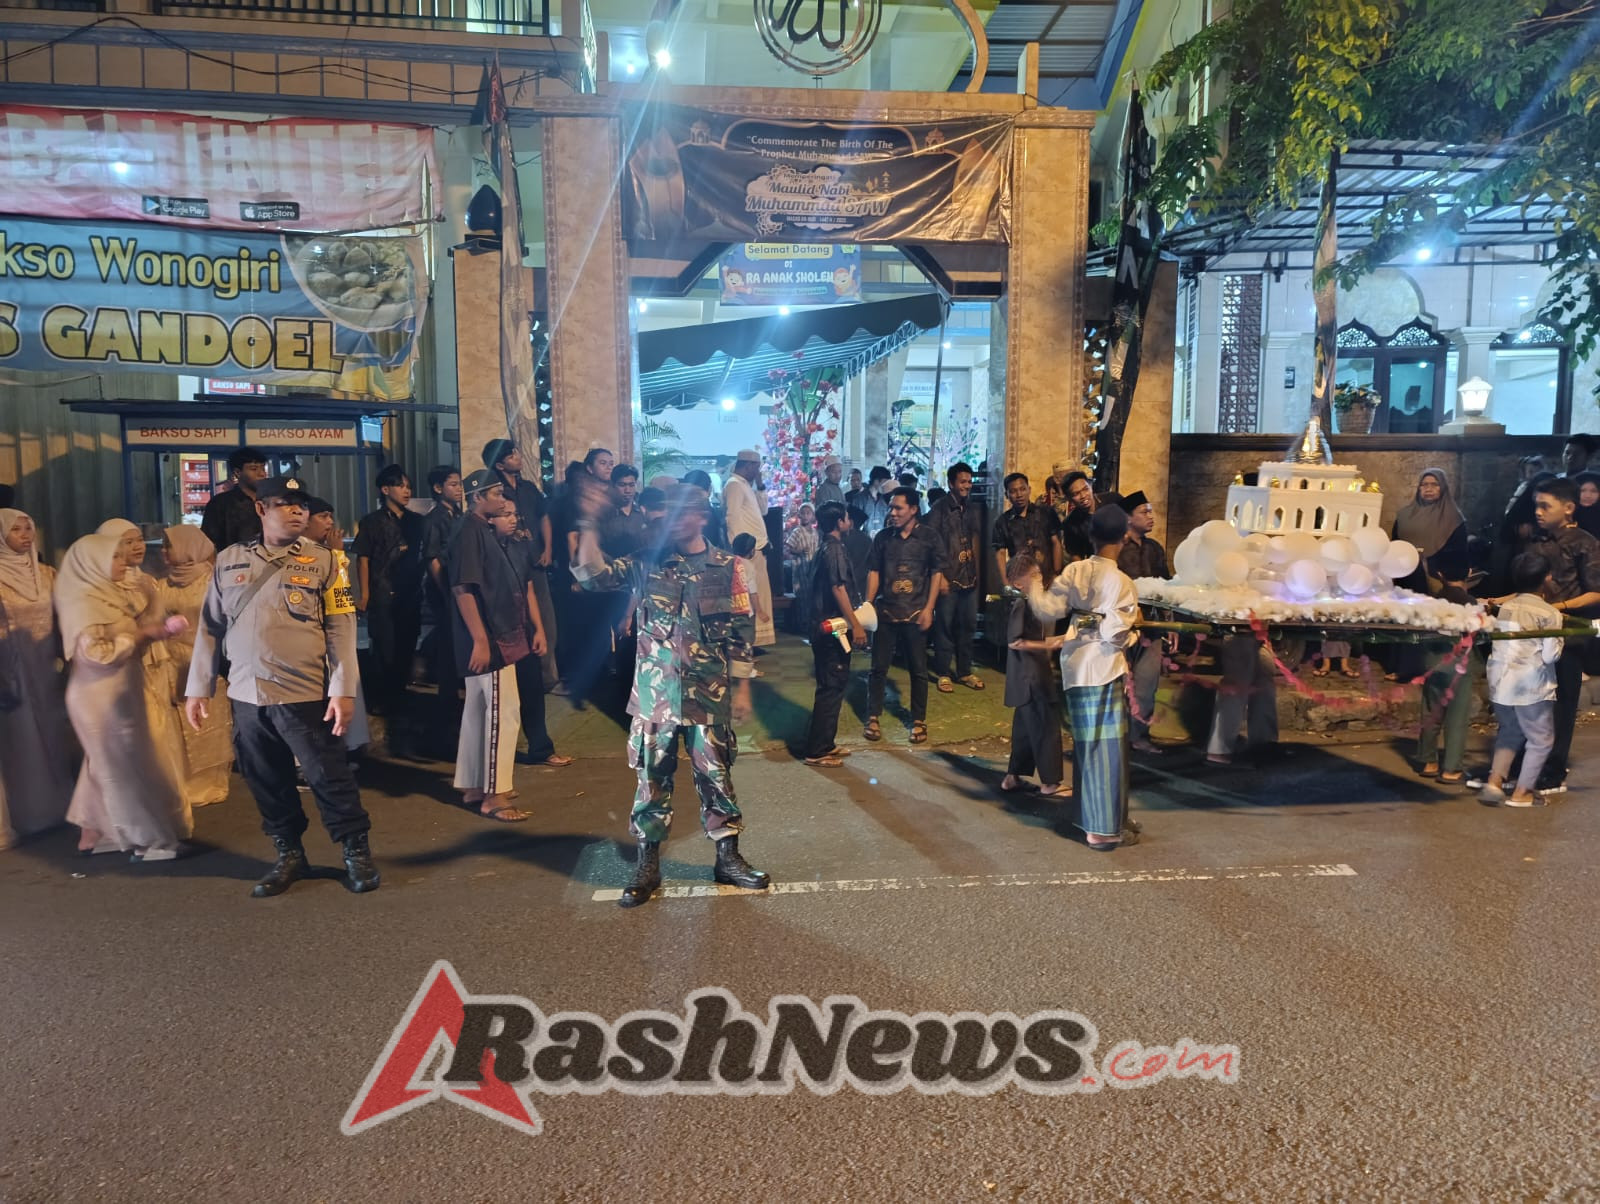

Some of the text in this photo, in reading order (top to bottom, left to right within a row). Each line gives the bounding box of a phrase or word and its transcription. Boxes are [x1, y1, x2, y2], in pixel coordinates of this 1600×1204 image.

[820, 139, 837, 148] The
[840, 140, 861, 148] Birth
[863, 140, 875, 148] Of
[878, 140, 894, 149] The
[761, 150, 796, 160] Prophet
[768, 182, 851, 195] Maulid Nabi
[747, 196, 846, 211] Muhammad
[189, 206, 205, 216] Play
[257, 209, 295, 219] App Store
[748, 244, 830, 255] Selamat Datang
[89, 235, 281, 299] Wonogiri
[746, 272, 760, 284] RA
[763, 272, 794, 283] ANAK
[42, 304, 345, 374] GANDOEL
[140, 427, 227, 439] BAKSO SAPI
[259, 428, 344, 439] BAKSO AYAM
[286, 564, 319, 573] POLRI
